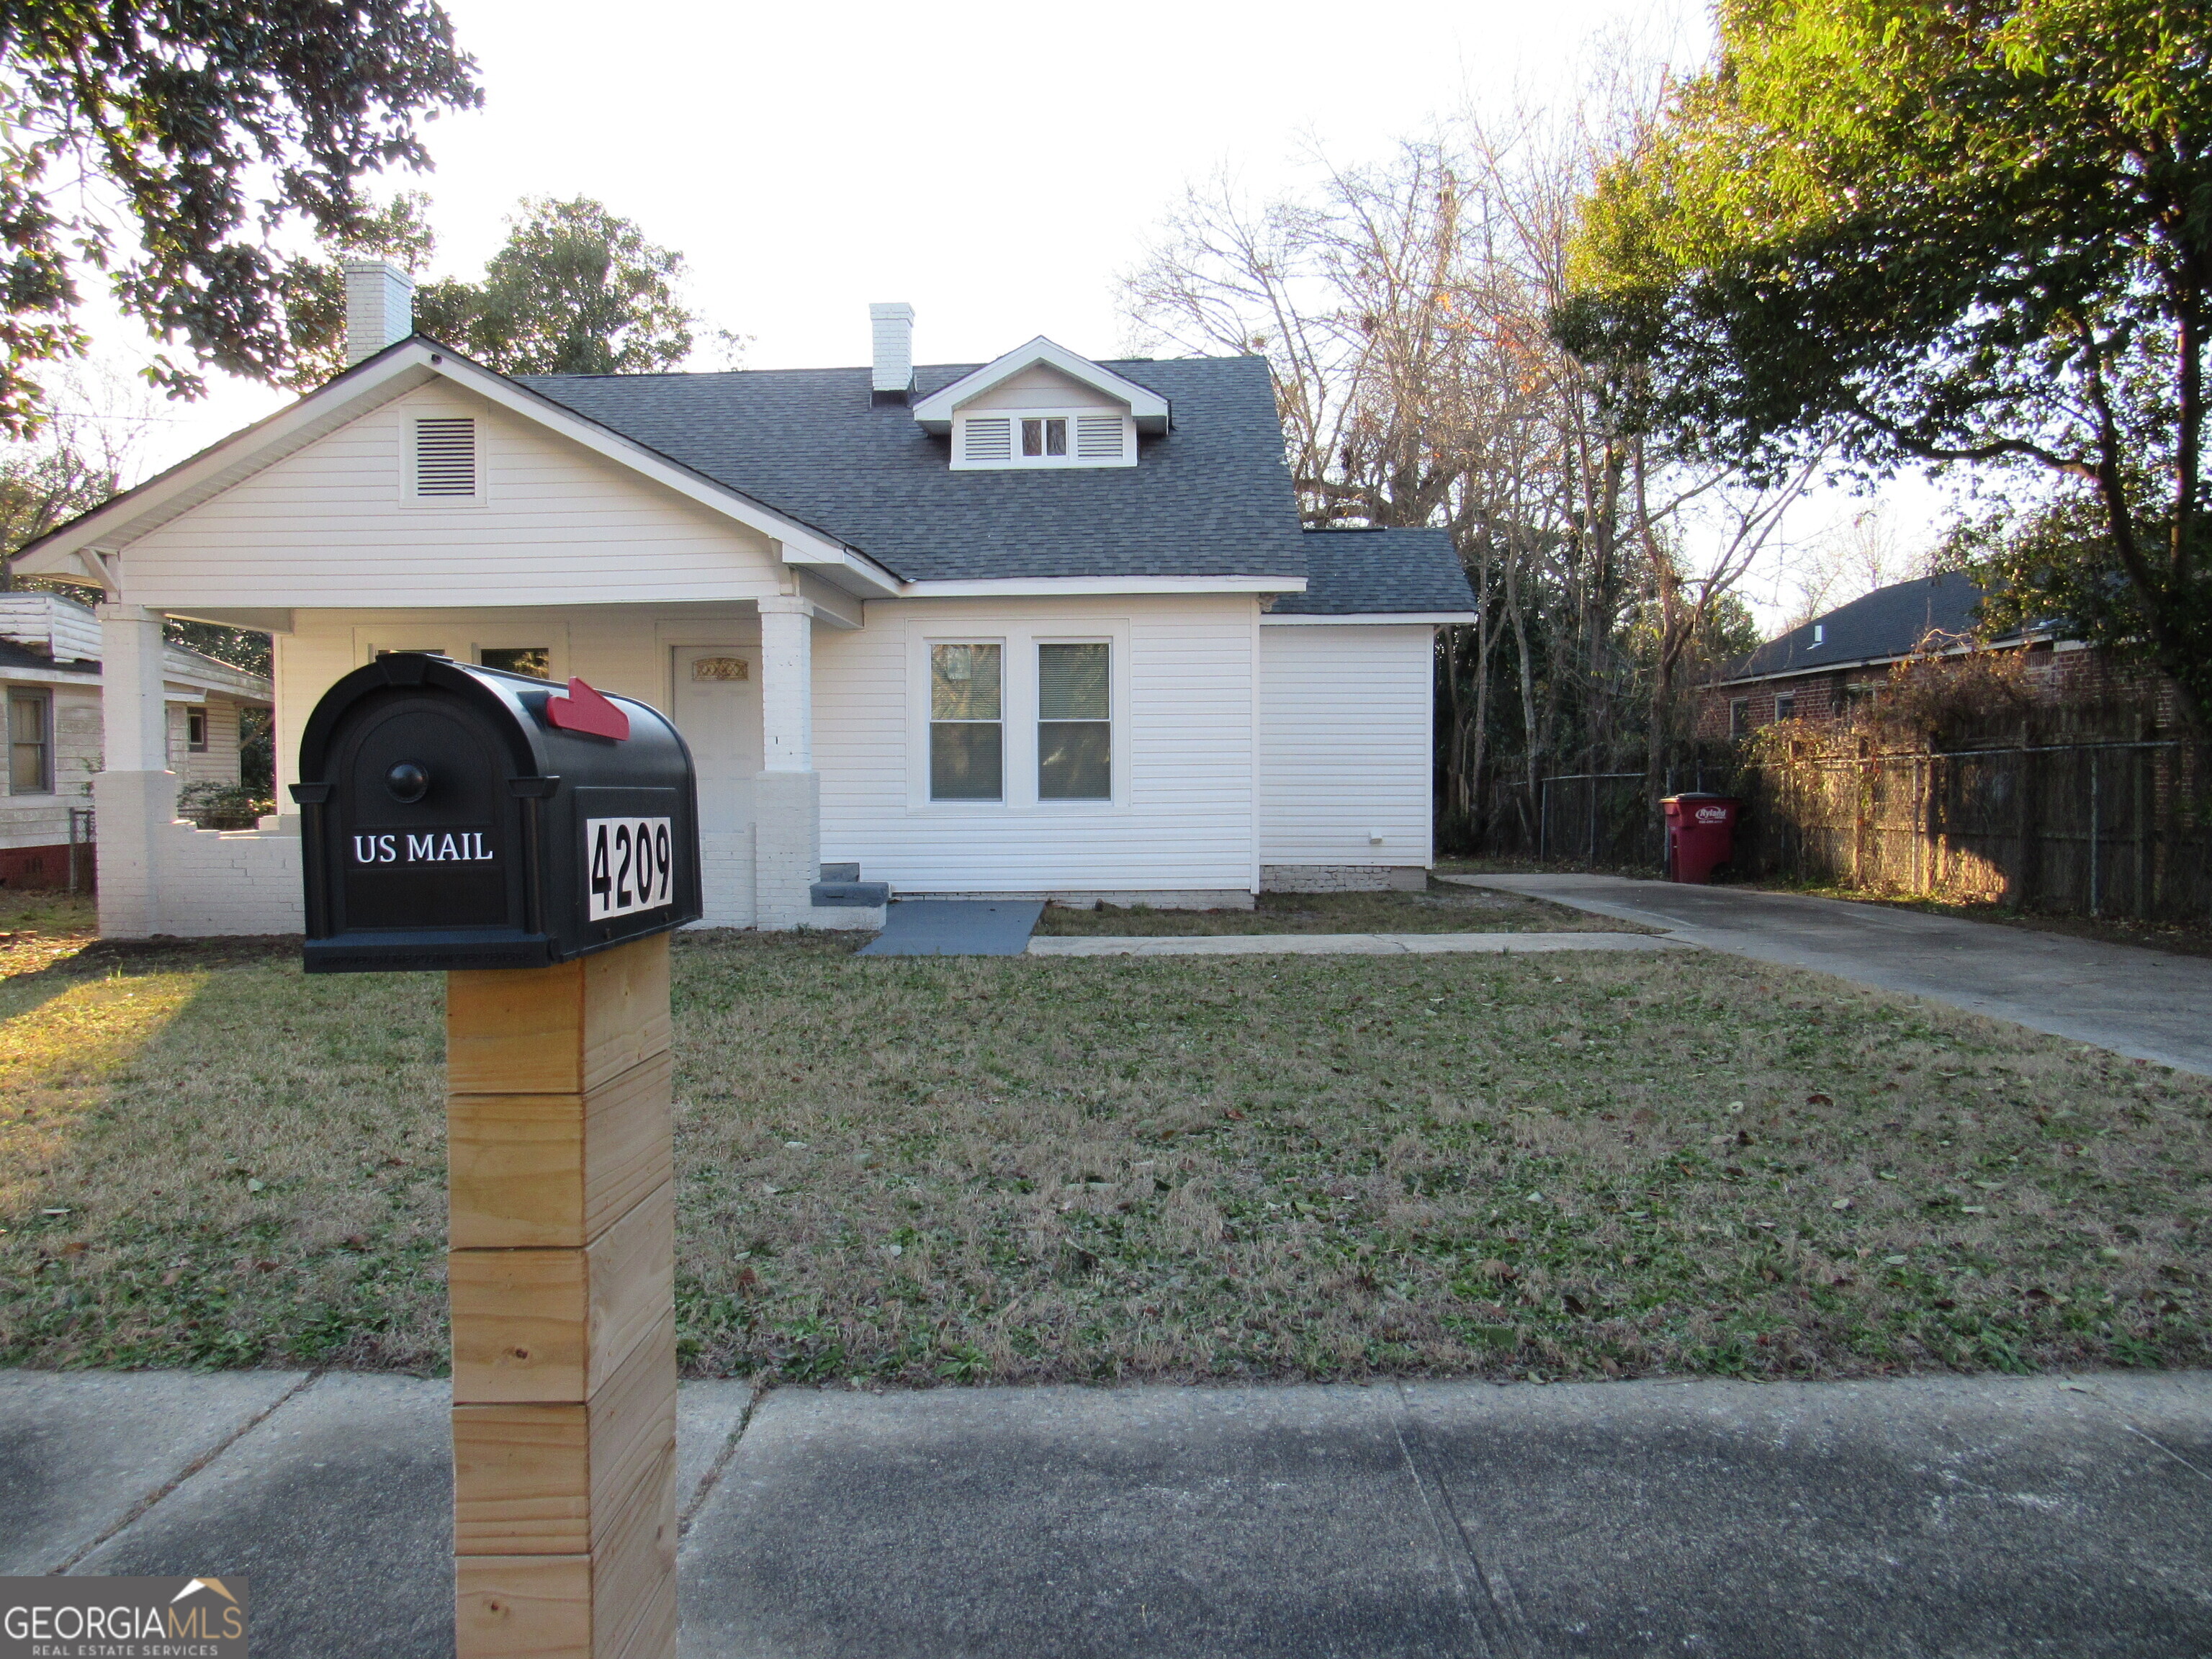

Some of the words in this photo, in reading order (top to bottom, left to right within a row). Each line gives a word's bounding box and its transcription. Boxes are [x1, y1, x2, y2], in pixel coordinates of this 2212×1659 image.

[1699, 809, 1727, 818] Ryland
[354, 835, 396, 863] US
[406, 832, 493, 862] MAIL
[592, 822, 670, 912] 4209
